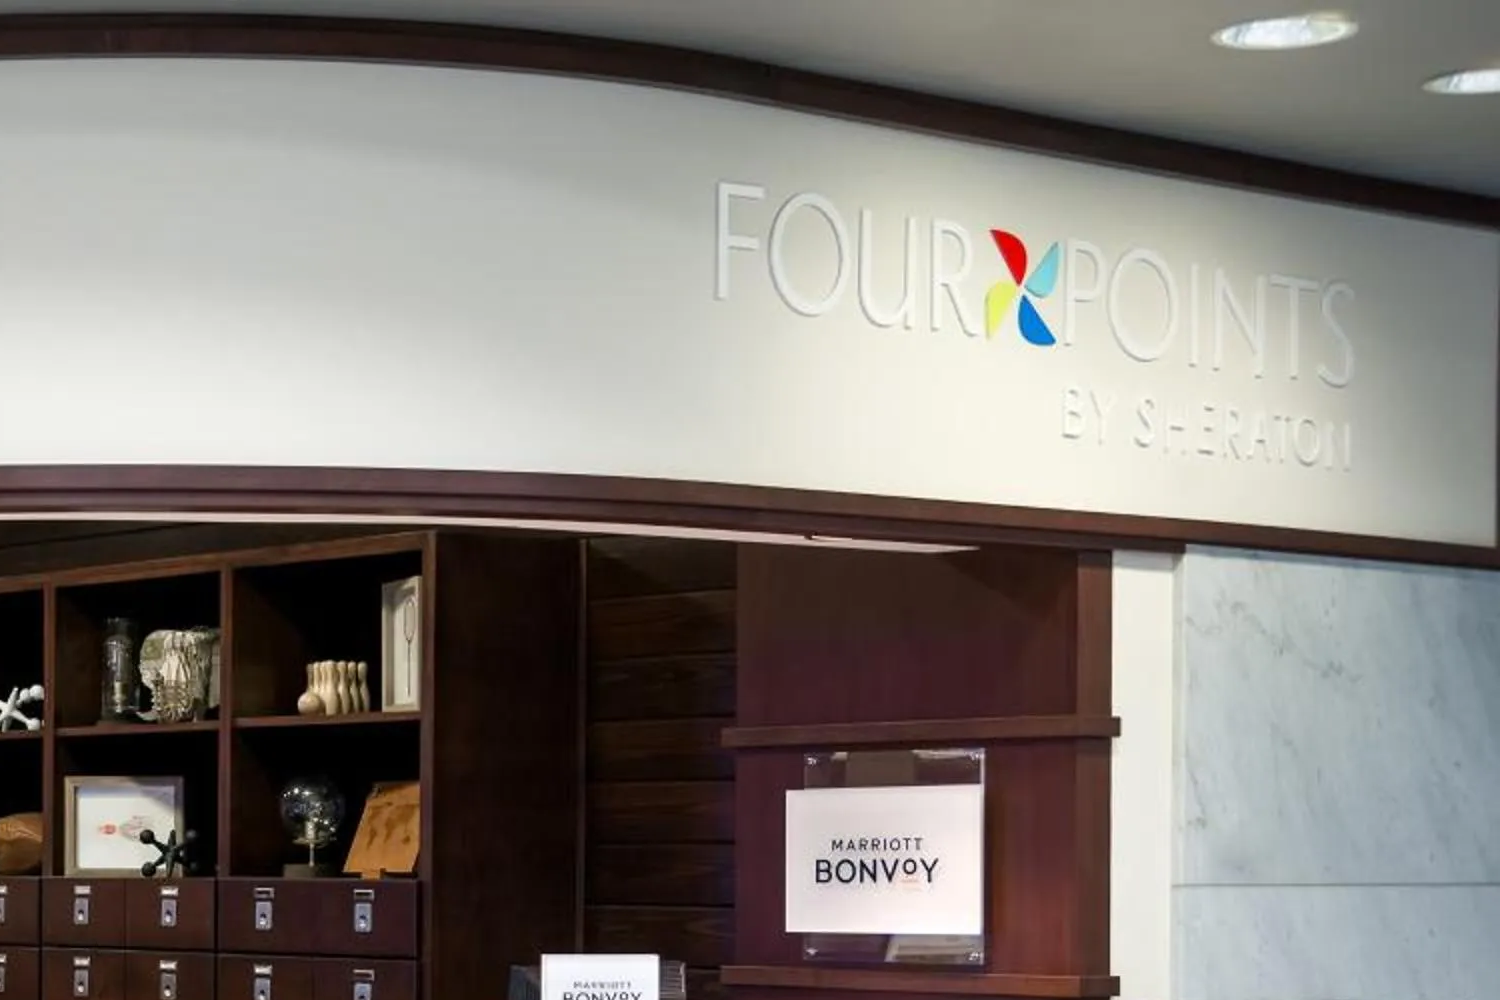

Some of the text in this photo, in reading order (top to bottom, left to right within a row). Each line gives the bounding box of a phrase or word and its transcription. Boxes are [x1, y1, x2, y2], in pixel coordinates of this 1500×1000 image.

[713, 181, 1357, 390] FOUR POINTS
[1061, 388, 1354, 473] BY SHERATON
[831, 837, 924, 852] MARRIOTT
